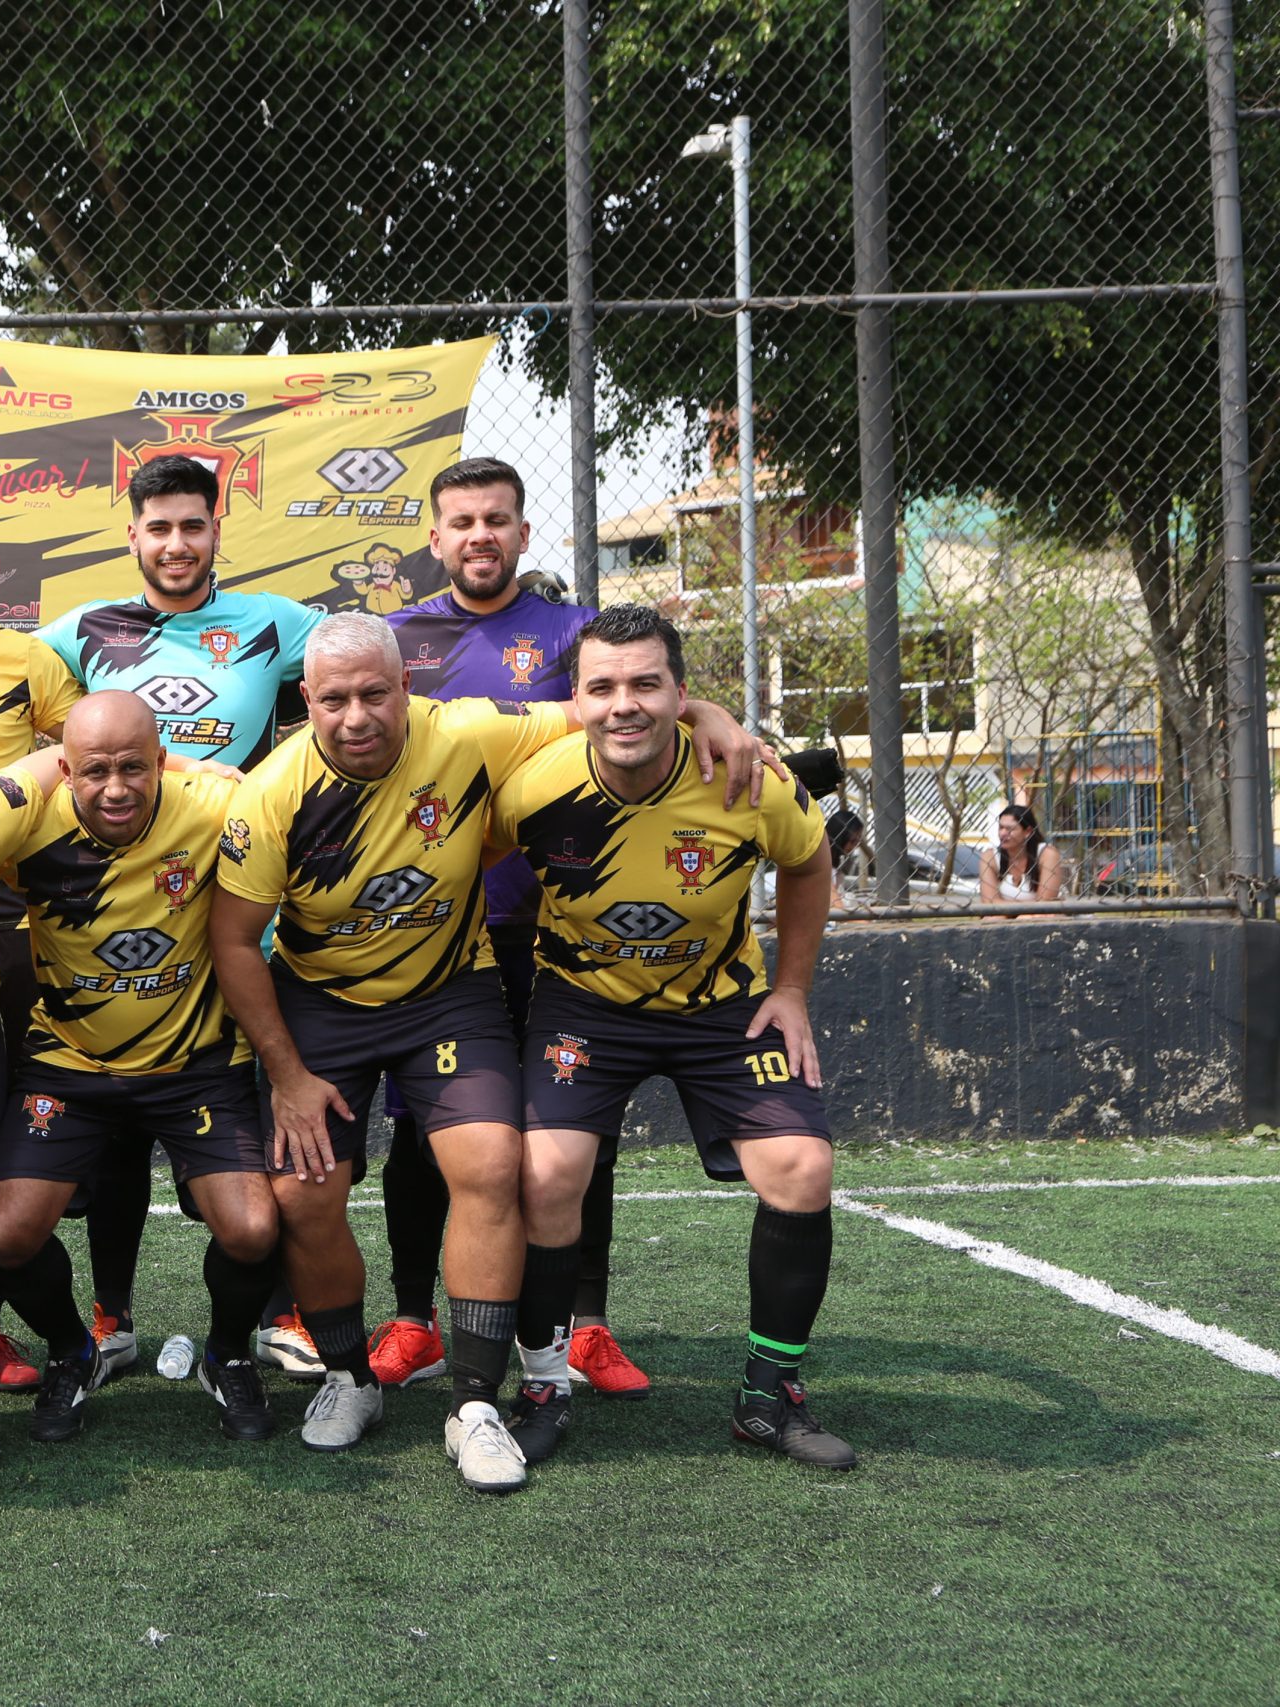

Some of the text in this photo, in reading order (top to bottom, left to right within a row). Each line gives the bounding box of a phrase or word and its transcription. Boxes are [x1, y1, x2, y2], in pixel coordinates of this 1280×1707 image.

[134, 390, 246, 409] AMIGOS
[292, 406, 416, 418] MULTIMARCAS
[24, 501, 51, 509] PIZZA
[286, 495, 423, 517] SE7E TR3S
[168, 718, 235, 737] TR3S
[556, 1032, 589, 1045] AMIGOS
[436, 1040, 457, 1074] 8
[744, 1051, 790, 1086] 10
